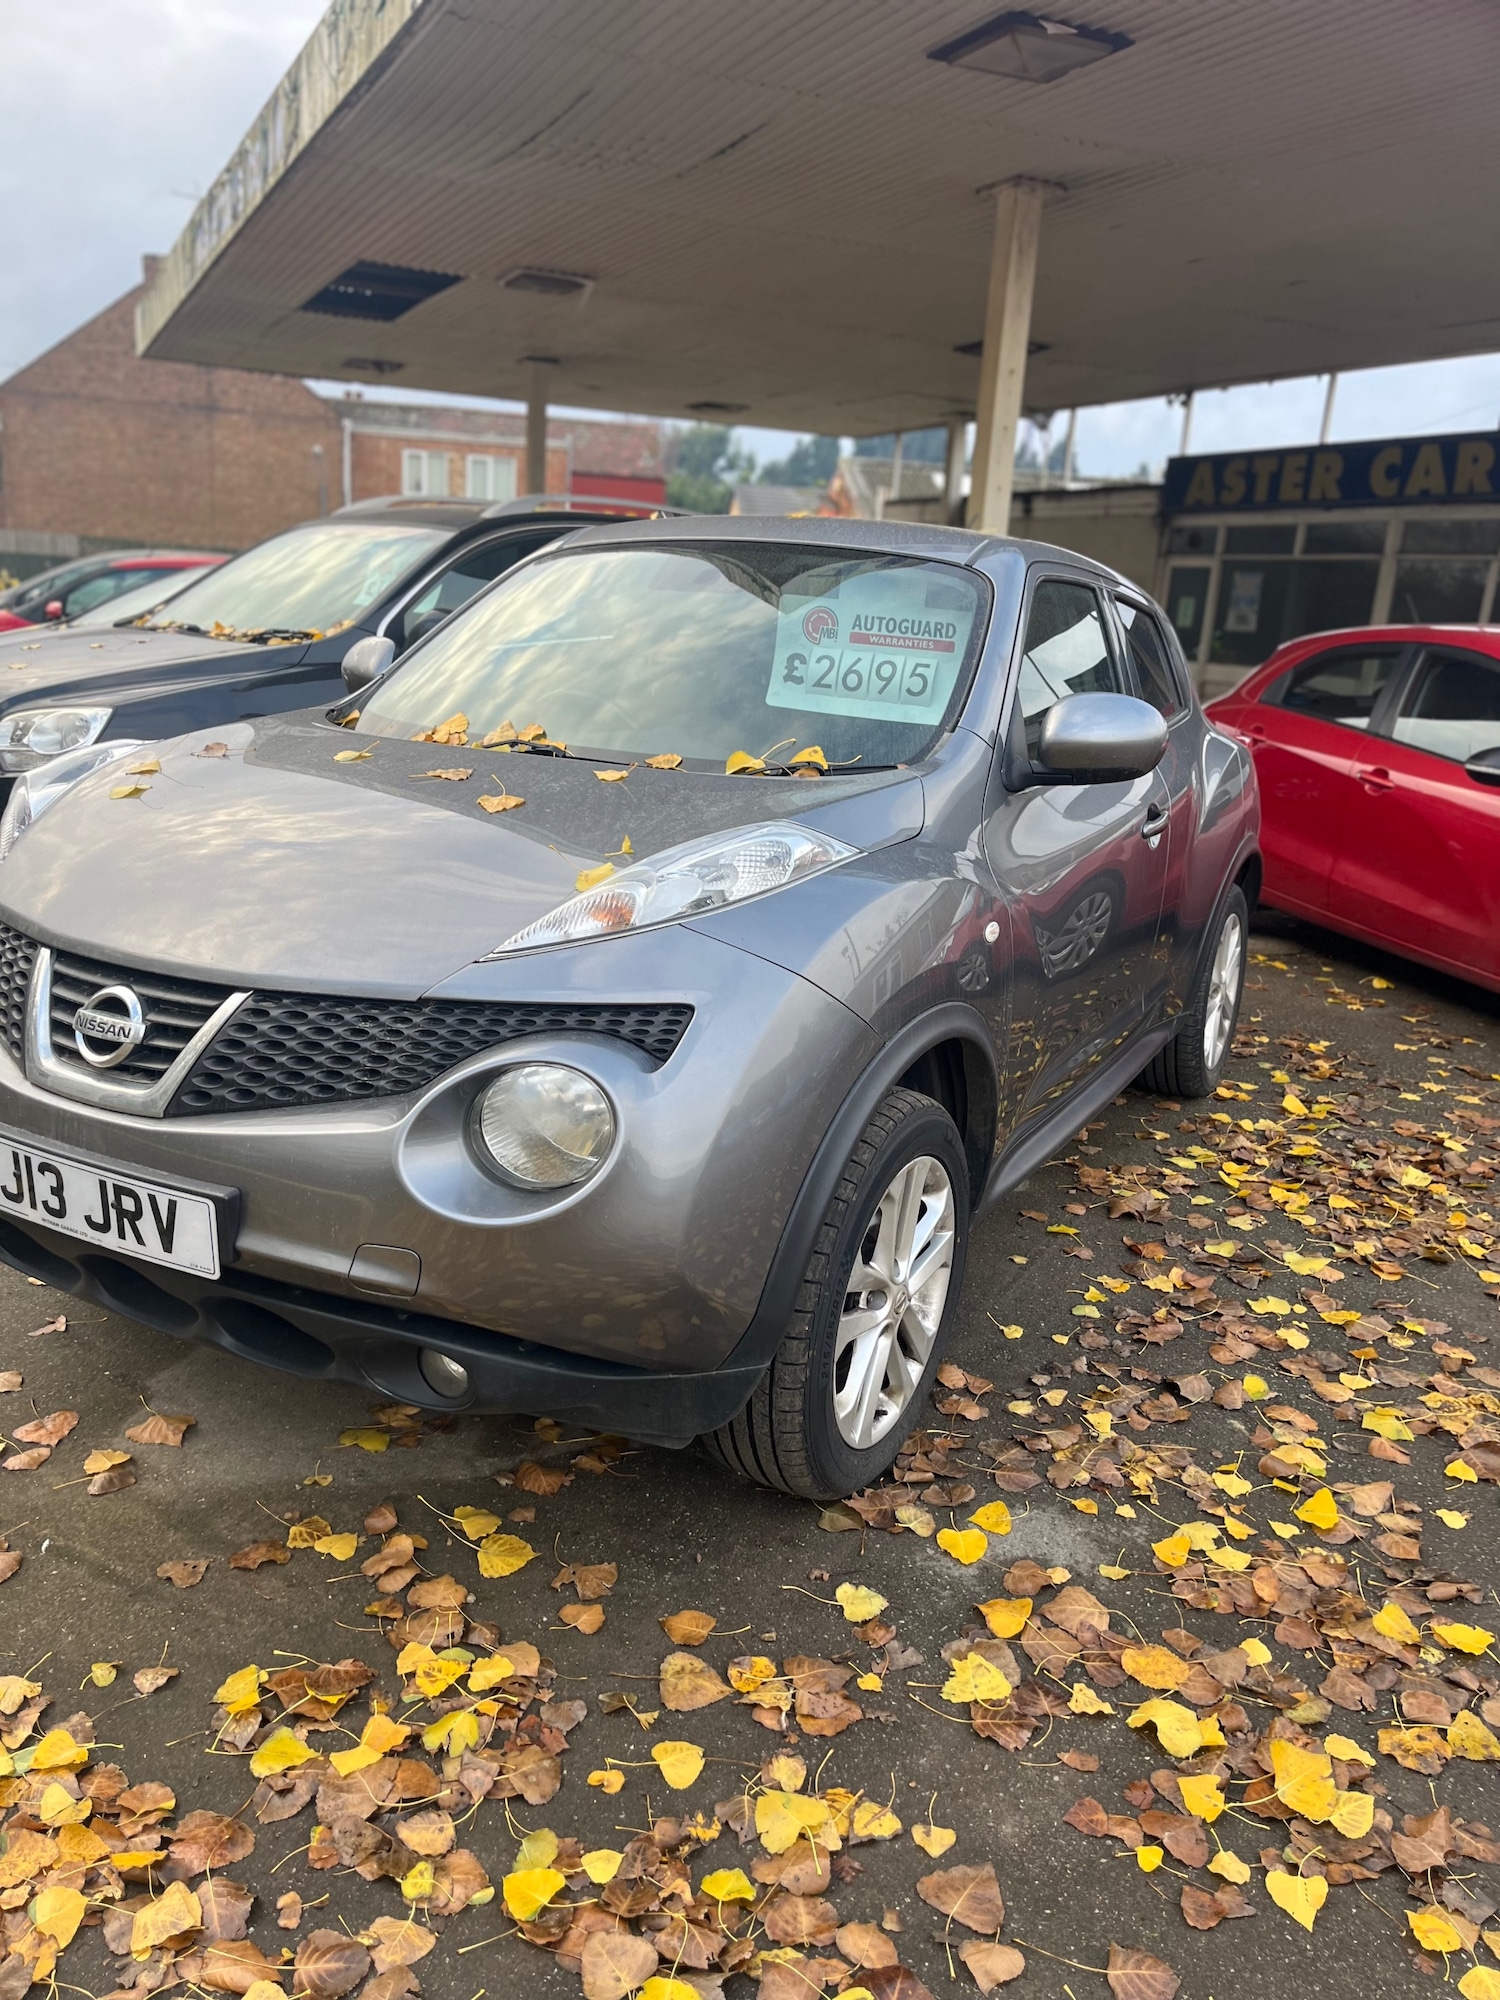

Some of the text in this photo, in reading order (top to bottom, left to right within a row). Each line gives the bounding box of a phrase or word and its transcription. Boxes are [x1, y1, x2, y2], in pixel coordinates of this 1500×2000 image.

[1184, 440, 1495, 506] ASTER CAR
[851, 614, 957, 639] AUTOGUARD
[869, 635, 934, 649] WARRANTIES
[782, 652, 931, 697] £2695
[76, 1015, 131, 1038] NISSAN
[0, 1151, 178, 1254] J13 JRV
[60, 1224, 79, 1234] GARAGE
